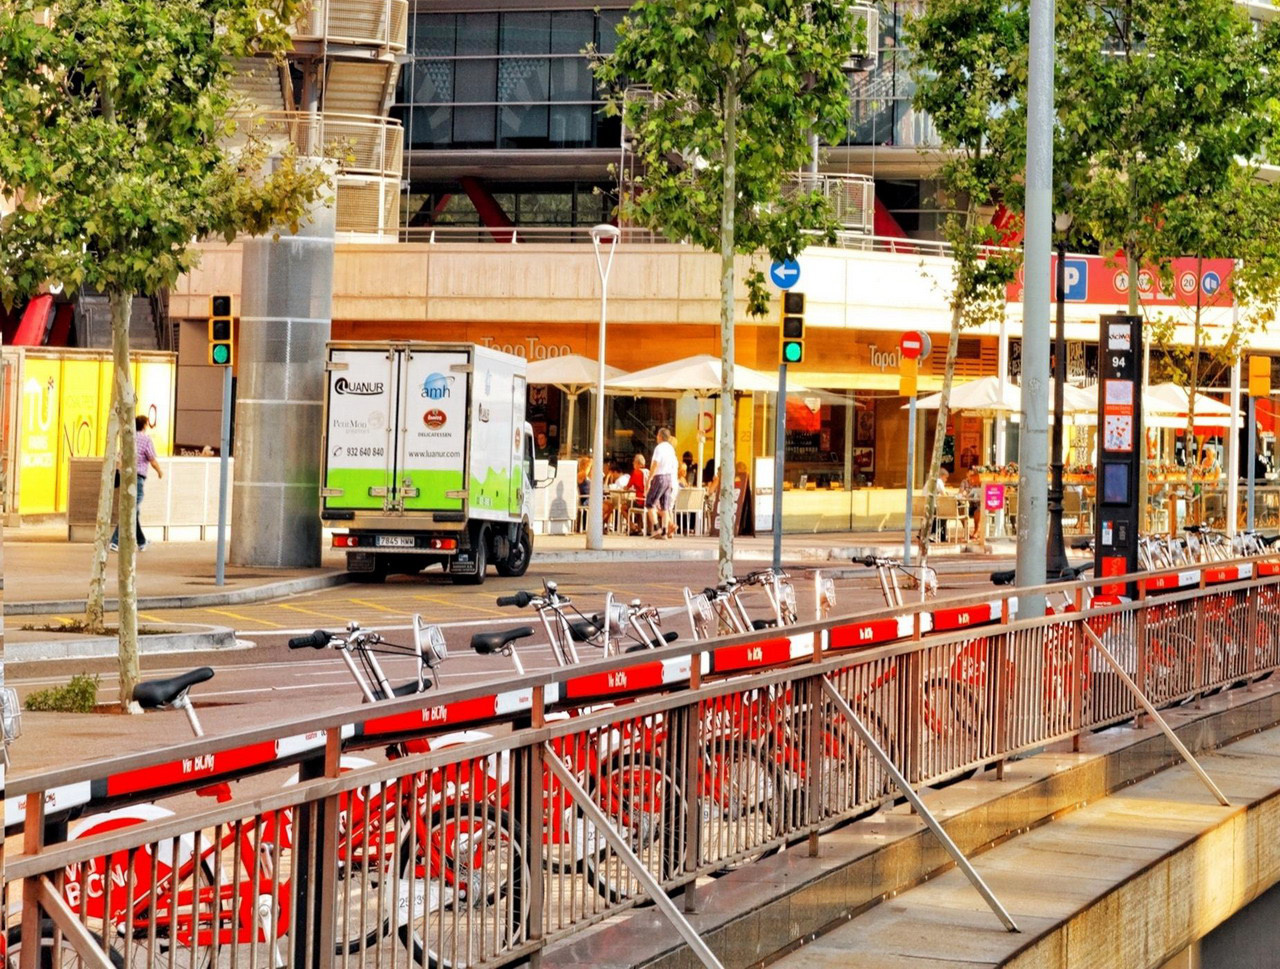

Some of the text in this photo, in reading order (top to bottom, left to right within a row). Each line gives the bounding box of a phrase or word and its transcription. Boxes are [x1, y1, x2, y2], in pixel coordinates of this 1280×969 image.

[1183, 278, 1195, 288] 20
[1112, 356, 1126, 368] 94
[346, 447, 384, 457] 932 640 840
[408, 450, 460, 458] www.luanur.com
